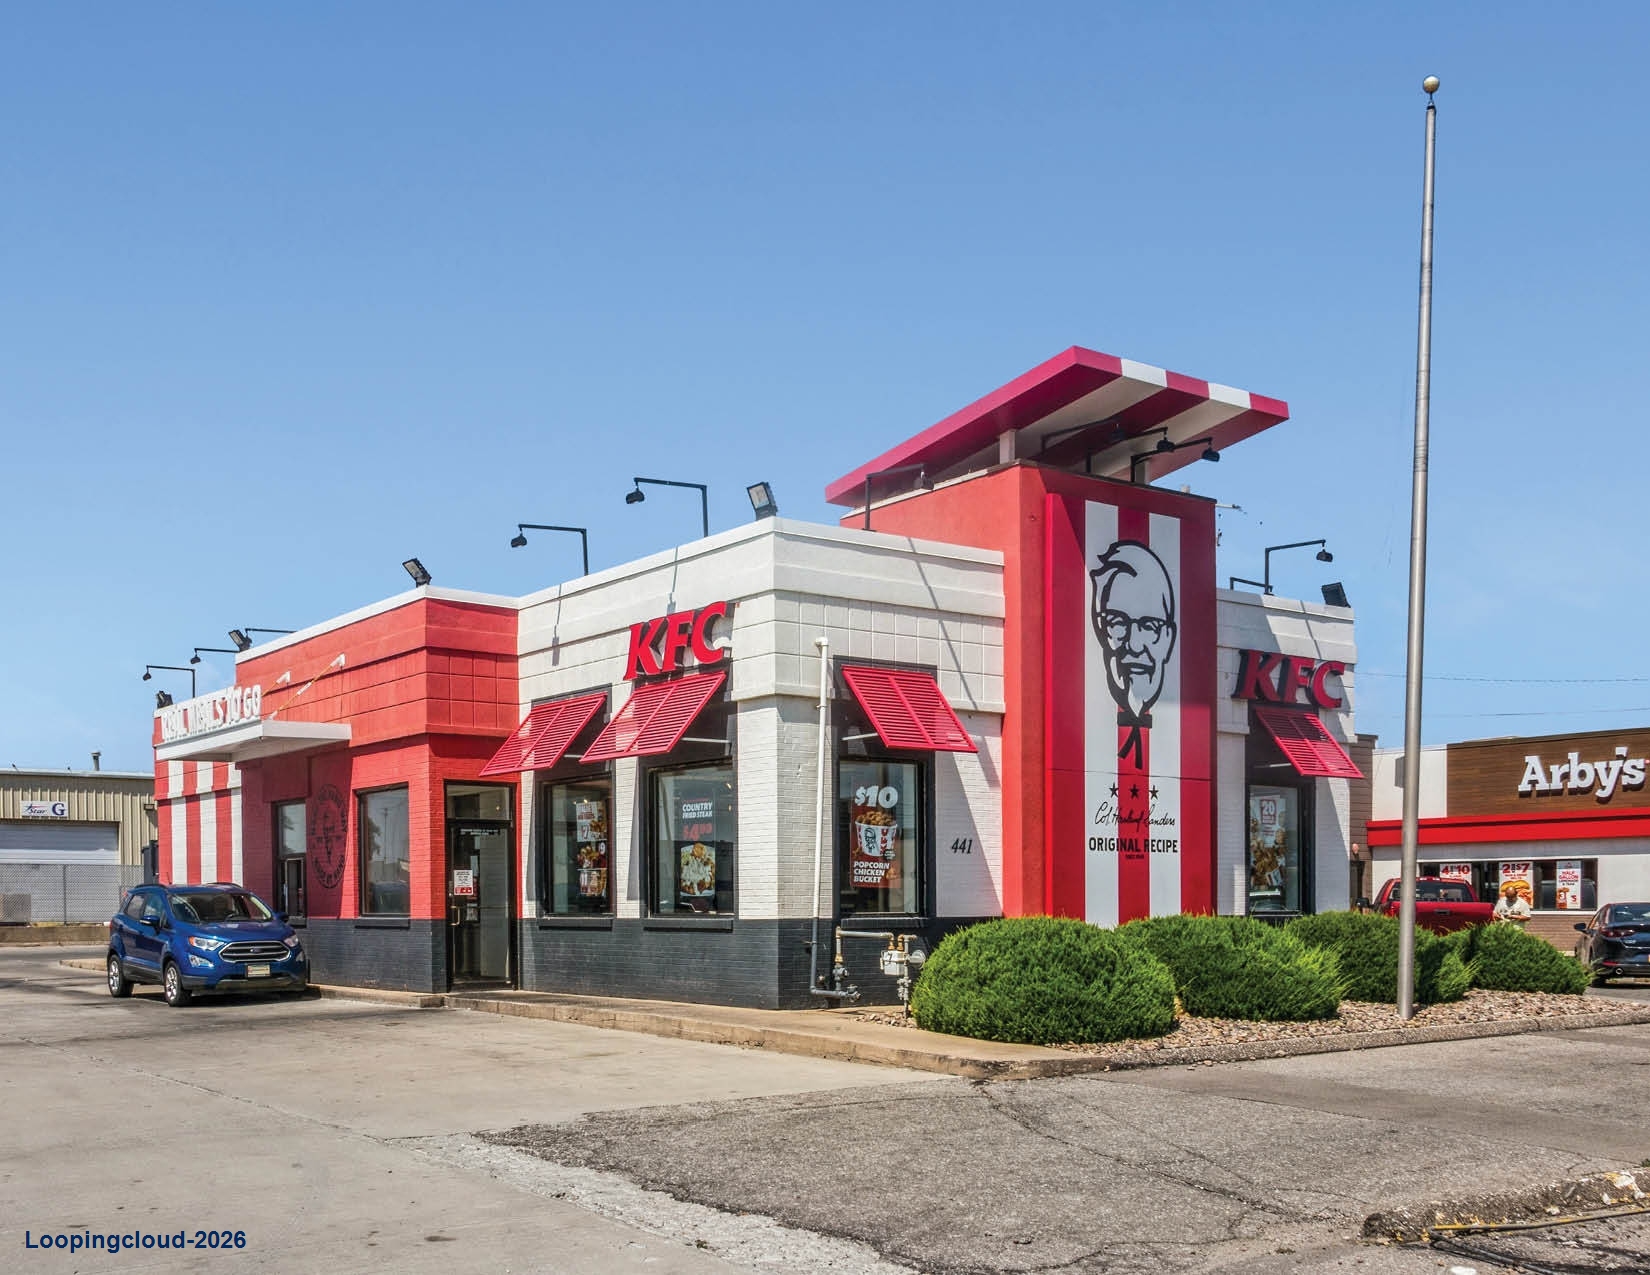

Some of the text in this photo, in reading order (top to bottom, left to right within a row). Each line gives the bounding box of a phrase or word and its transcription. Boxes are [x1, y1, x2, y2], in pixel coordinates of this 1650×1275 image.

[623, 600, 728, 681] KFC
[1234, 648, 1346, 710] KFC
[243, 684, 261, 719] GO
[1518, 746, 1645, 799] Arby's
[854, 785, 899, 809] $10
[51, 802, 67, 816] G
[682, 801, 713, 812] COUNTRY
[697, 810, 713, 818] STEAK
[951, 837, 973, 854] 441
[1088, 836, 1179, 853] ORIGINAL RECIPE
[853, 860, 890, 870] POPCORN
[853, 867, 886, 877] CHICKEN
[1502, 863, 1511, 874] 2
[1516, 863, 1531, 873] $7
[853, 875, 883, 884] BUCKET
